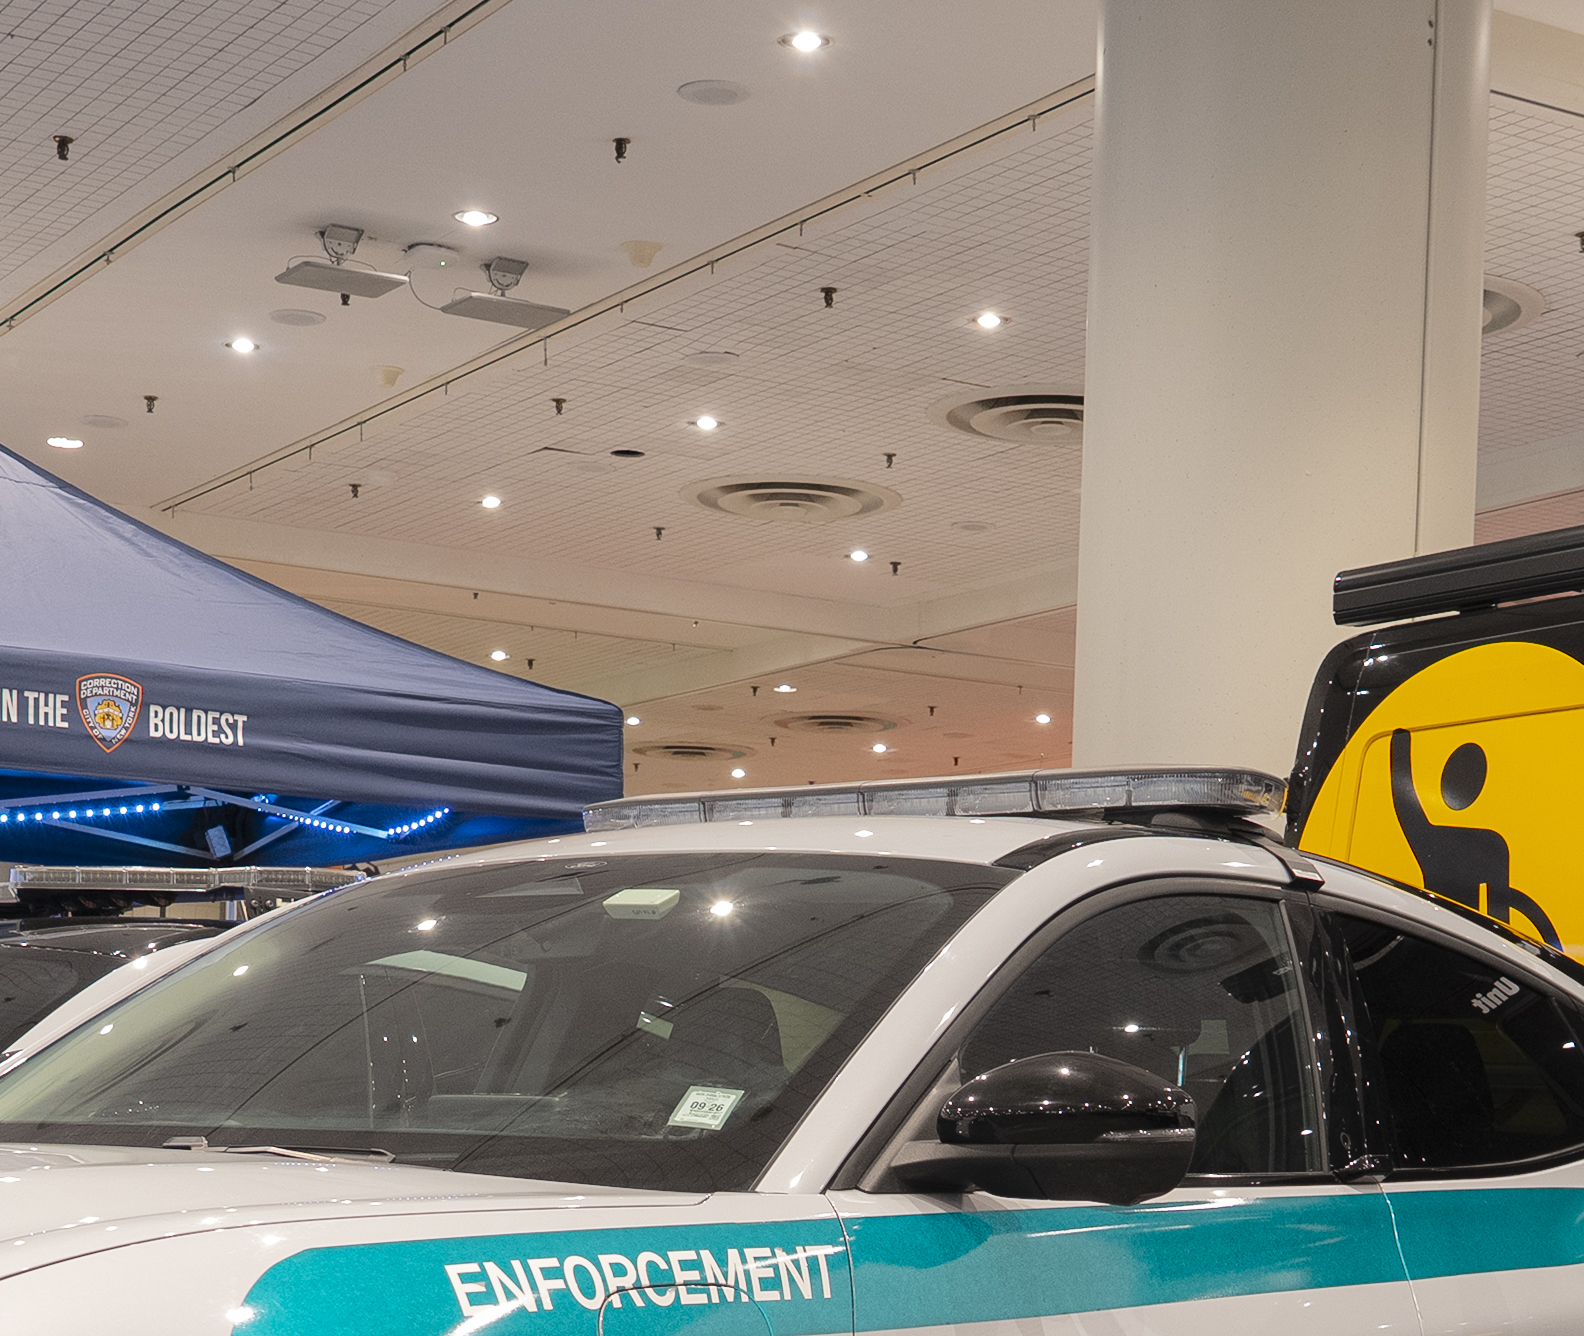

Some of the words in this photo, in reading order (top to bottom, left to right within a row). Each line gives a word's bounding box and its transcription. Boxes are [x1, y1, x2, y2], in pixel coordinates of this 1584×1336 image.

[81, 678, 138, 696] CORRECTION
[81, 687, 138, 704] DEPARTMENT
[24, 690, 69, 728] THE
[149, 704, 248, 747] BOLDEST
[83, 708, 95, 728] CITY
[93, 728, 104, 739] OF
[111, 728, 127, 744] NEW
[124, 705, 137, 728] YORK
[690, 1101, 706, 1111] 09
[708, 1103, 725, 1112] 26
[444, 1244, 834, 1317] ENFORCEMENT
